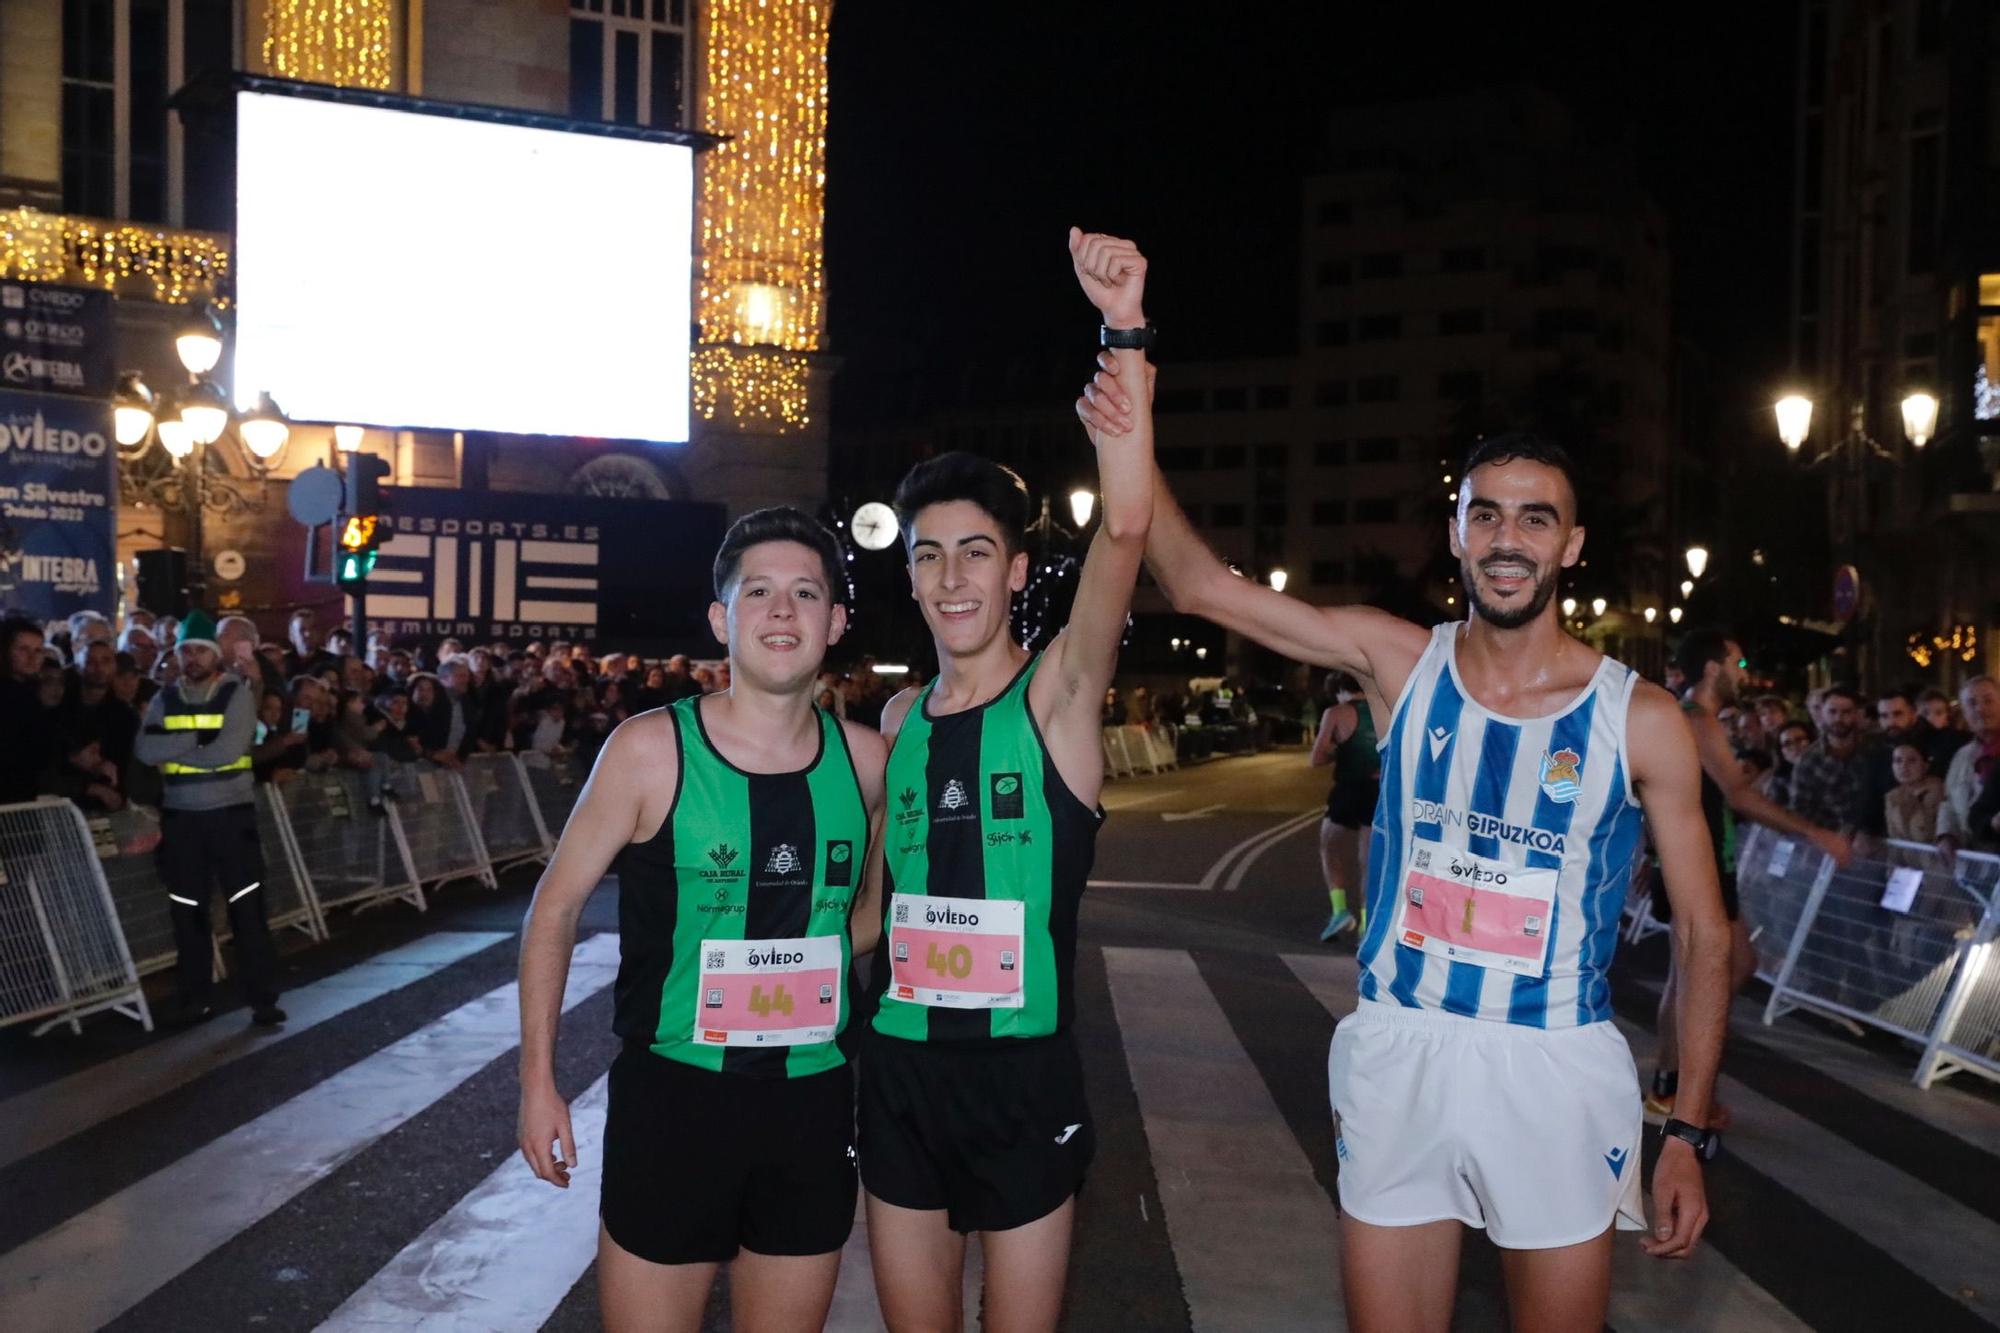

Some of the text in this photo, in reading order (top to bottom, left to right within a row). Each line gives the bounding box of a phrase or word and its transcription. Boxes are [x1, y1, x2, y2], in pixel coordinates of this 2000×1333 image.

[23, 482, 105, 507] Silvestre
[22, 554, 98, 584] INTEGRA
[491, 624, 597, 640] SPORTS
[1467, 814, 1565, 854] GIPUZKOA
[1451, 861, 1507, 885] OVIEDO
[926, 904, 979, 926] OVIEDO
[748, 946, 804, 968] OVIEDO
[926, 942, 974, 979] 40
[748, 984, 794, 1018] 44
